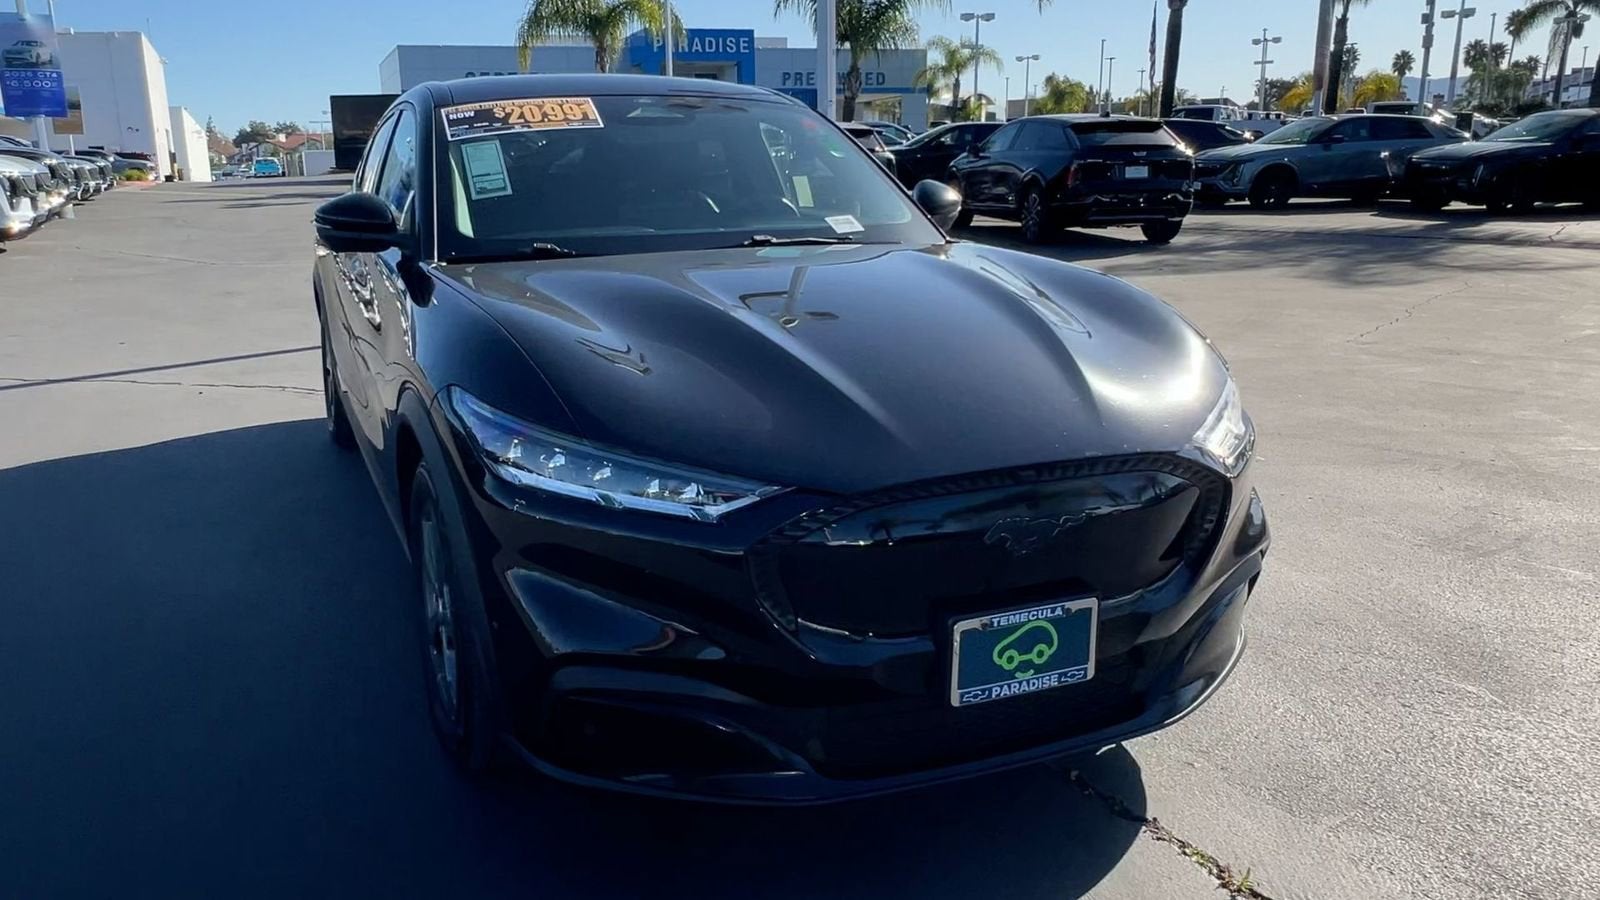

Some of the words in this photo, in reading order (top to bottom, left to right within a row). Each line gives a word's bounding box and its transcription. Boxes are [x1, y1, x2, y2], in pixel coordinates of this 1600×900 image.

[653, 37, 750, 53] PRADISE
[449, 111, 474, 120] NOW
[993, 607, 1063, 627] TEMECULA
[992, 675, 1058, 698] PARADISE
